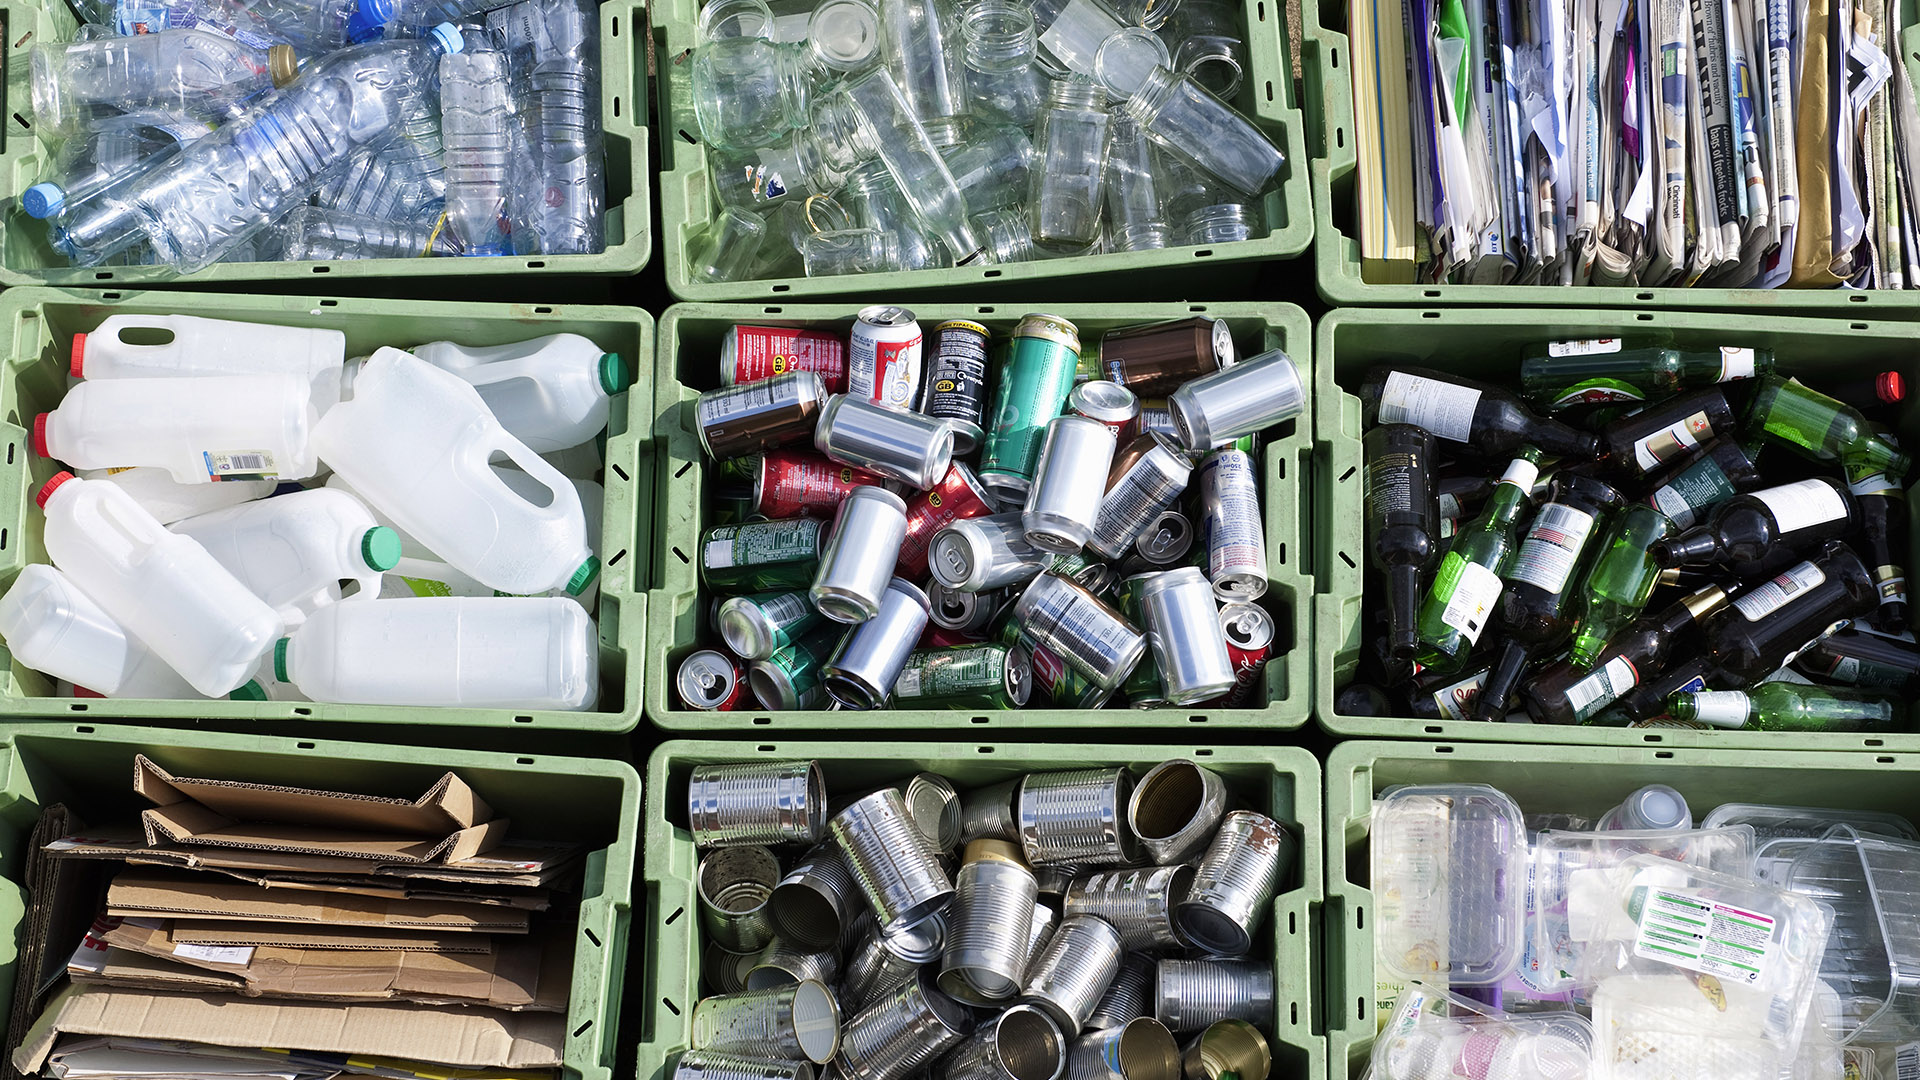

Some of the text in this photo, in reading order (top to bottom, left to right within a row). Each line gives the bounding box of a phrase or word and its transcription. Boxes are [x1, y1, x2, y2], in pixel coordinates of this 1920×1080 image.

[1704, 1, 1713, 25] Brown
[521, 15, 534, 41] 500ml
[1707, 27, 1716, 35] of
[1711, 63, 1721, 77] and
[1710, 127, 1721, 149] bags
[1713, 150, 1723, 158] of
[1673, 185, 1681, 219] Cincinnati
[1718, 190, 1728, 216] frocks
[1490, 242, 1498, 253] BT
[773, 357, 783, 371] GB
[937, 382, 952, 391] GB
[930, 492, 942, 506] GB
